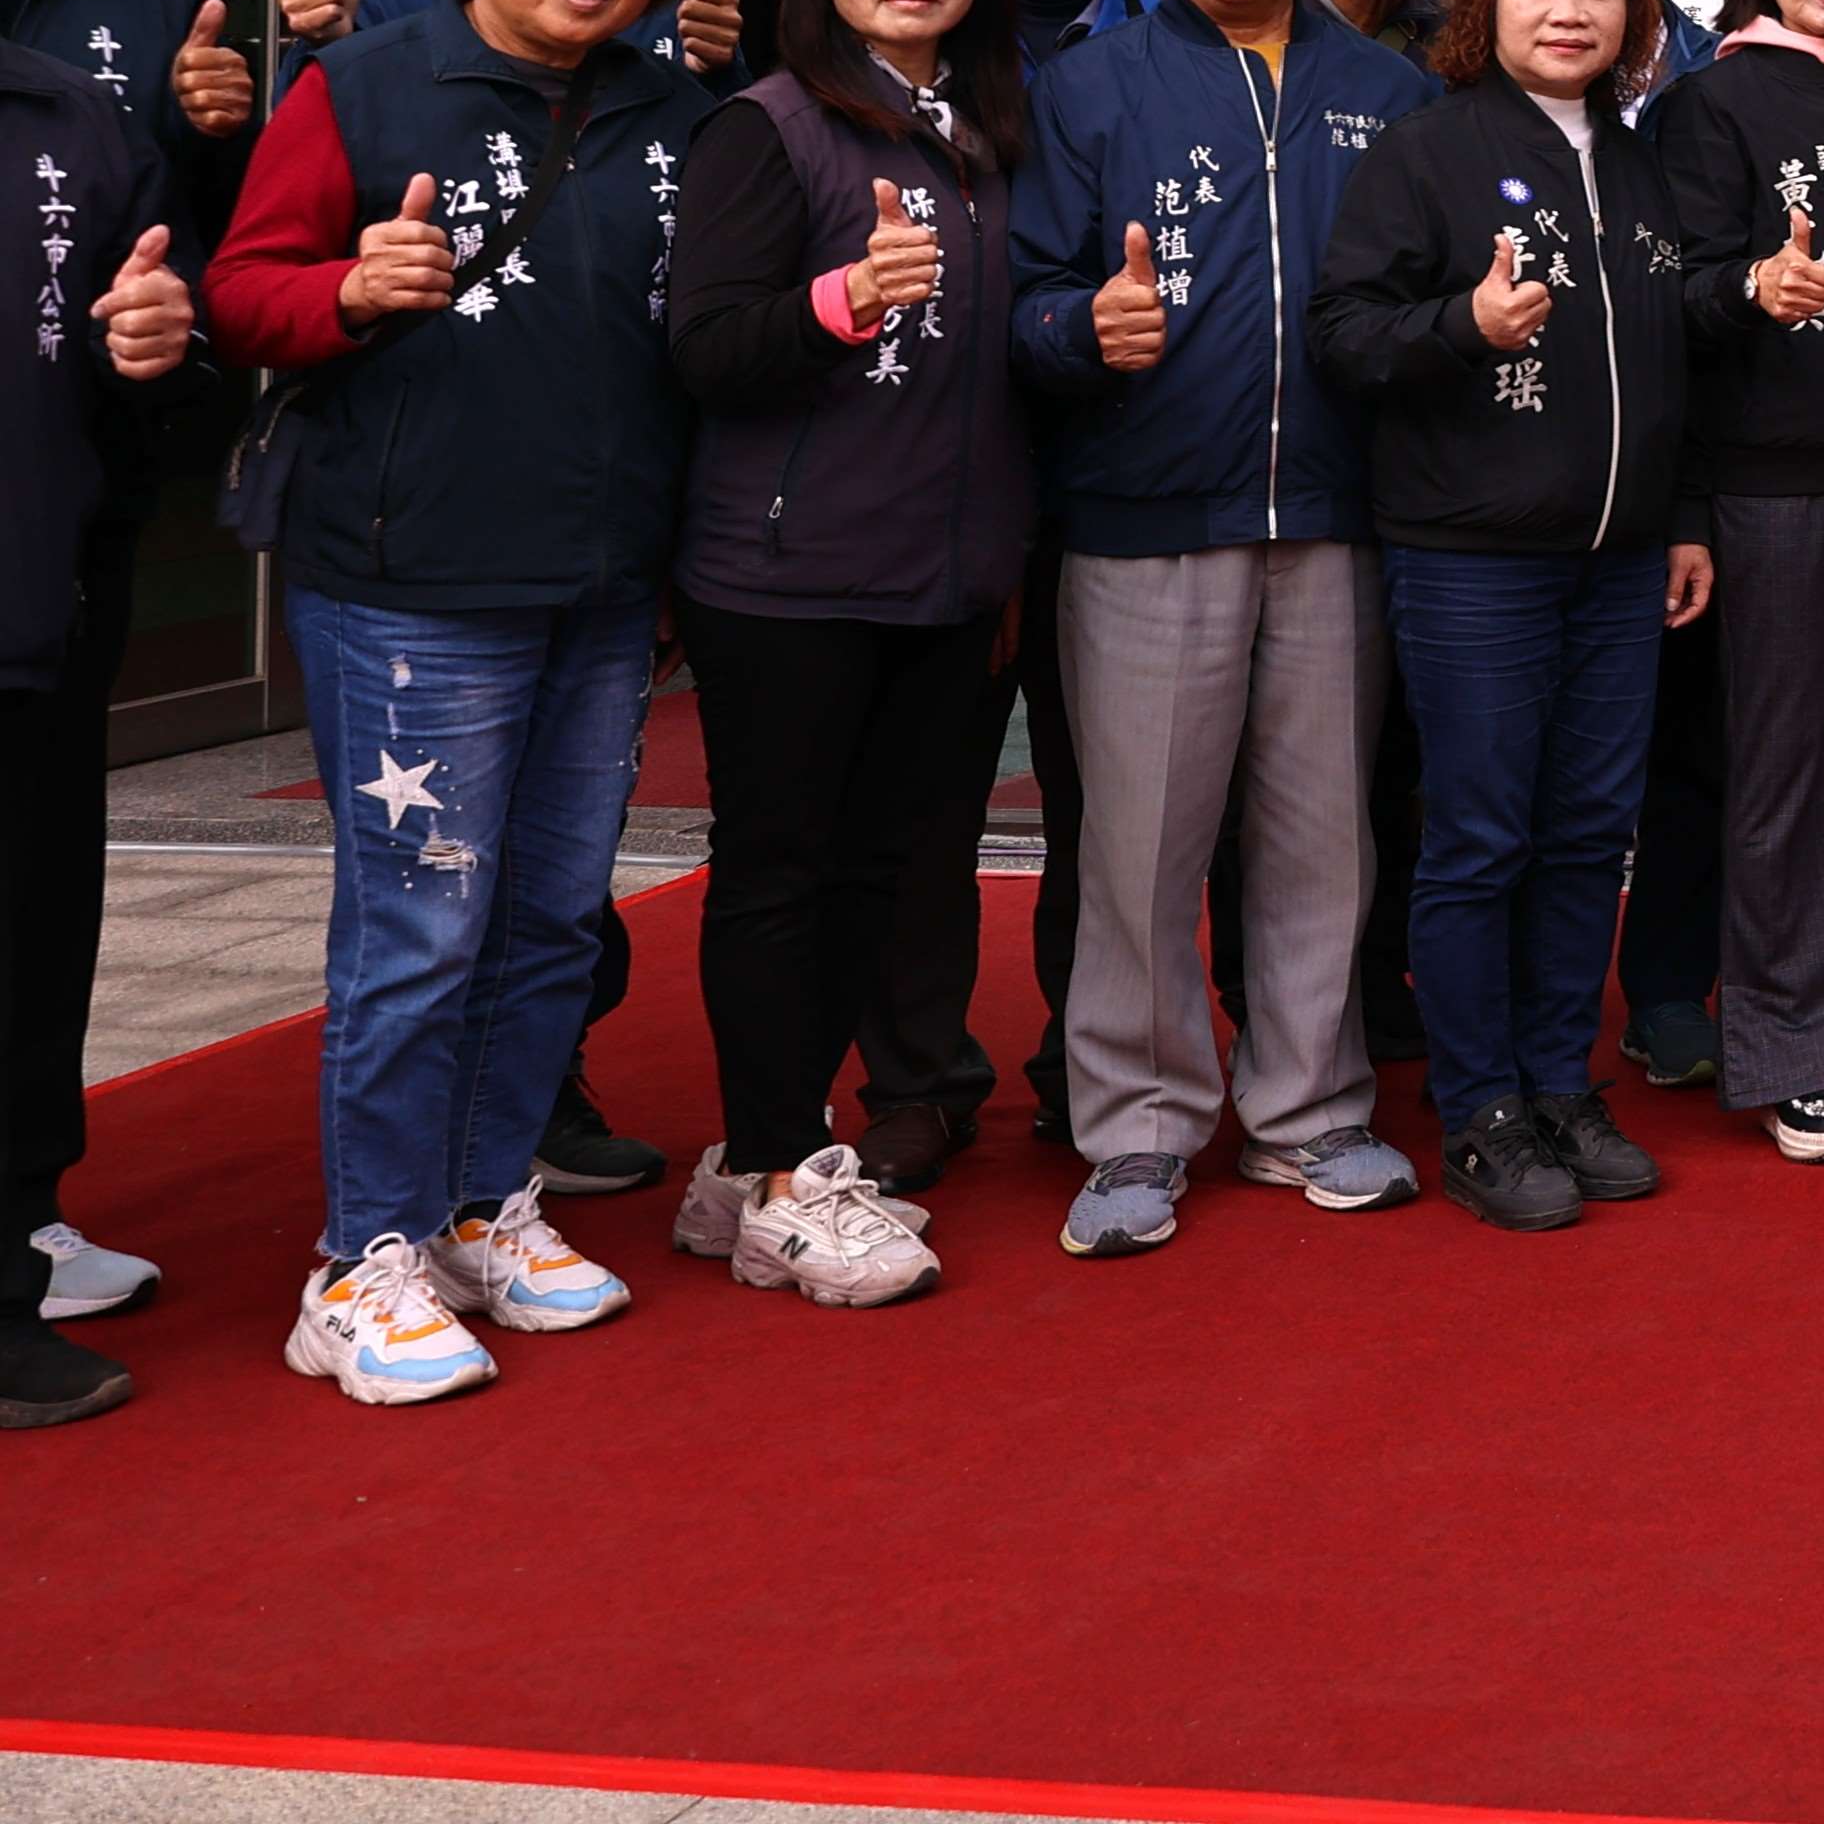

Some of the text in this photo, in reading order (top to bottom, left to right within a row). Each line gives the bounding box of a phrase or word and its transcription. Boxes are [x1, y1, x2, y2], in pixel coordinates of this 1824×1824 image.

[1189, 145, 1223, 204] 代表
[35, 153, 76, 363] 斗六市公所
[1533, 208, 1577, 288] 代表
